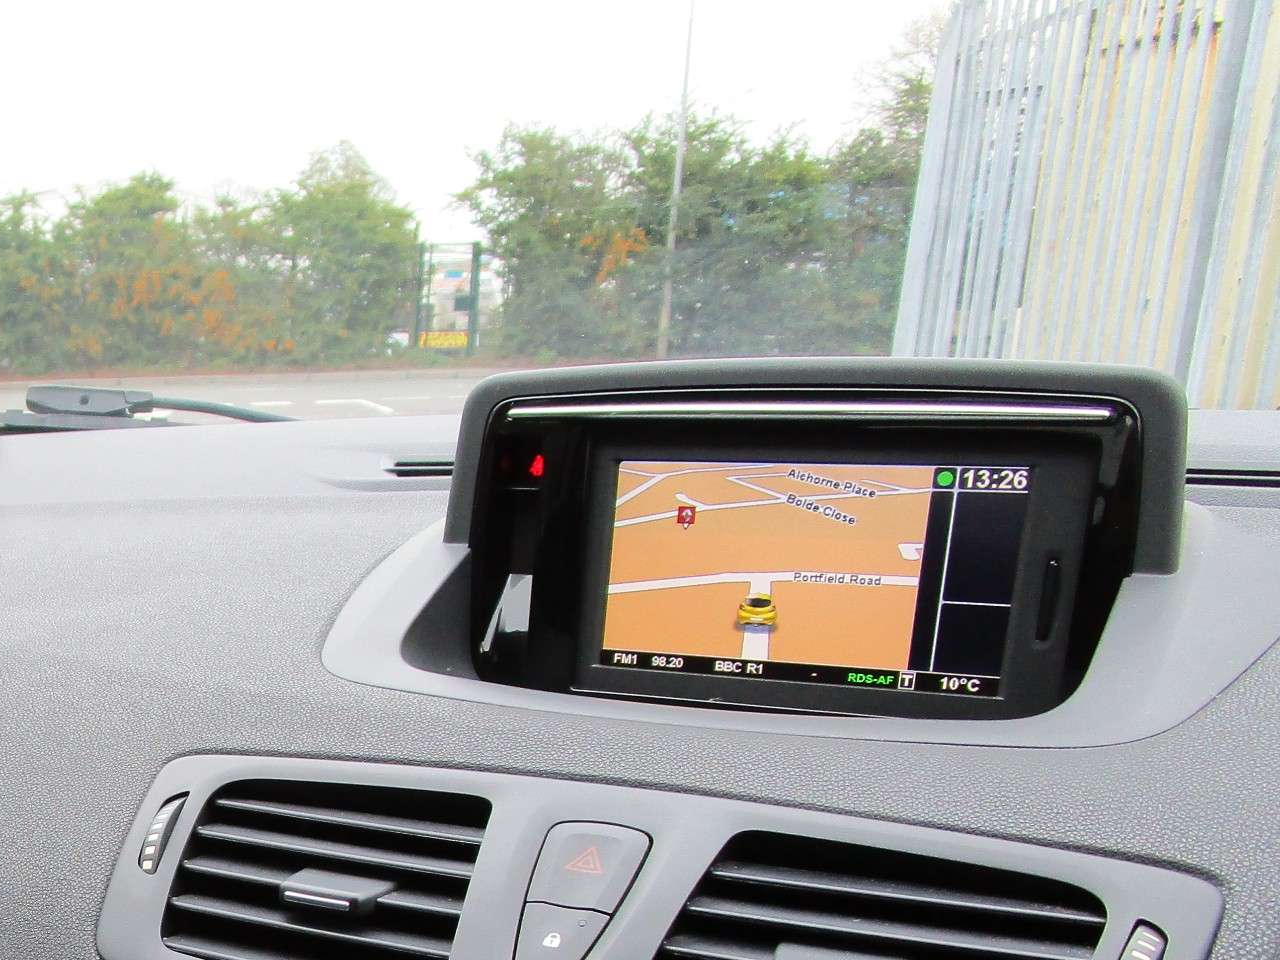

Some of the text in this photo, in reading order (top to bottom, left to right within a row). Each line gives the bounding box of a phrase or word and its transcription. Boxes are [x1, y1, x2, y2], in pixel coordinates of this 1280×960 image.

[963, 469, 1028, 489] 13:26
[844, 482, 877, 498] Place
[786, 494, 856, 525] Bolde Close
[793, 572, 882, 586] Portfield Road
[613, 653, 638, 665] FM1
[651, 656, 684, 669] 98.20
[714, 661, 764, 675] BBC R1
[847, 672, 895, 685] RDS-AF
[940, 676, 981, 692] 10°C
